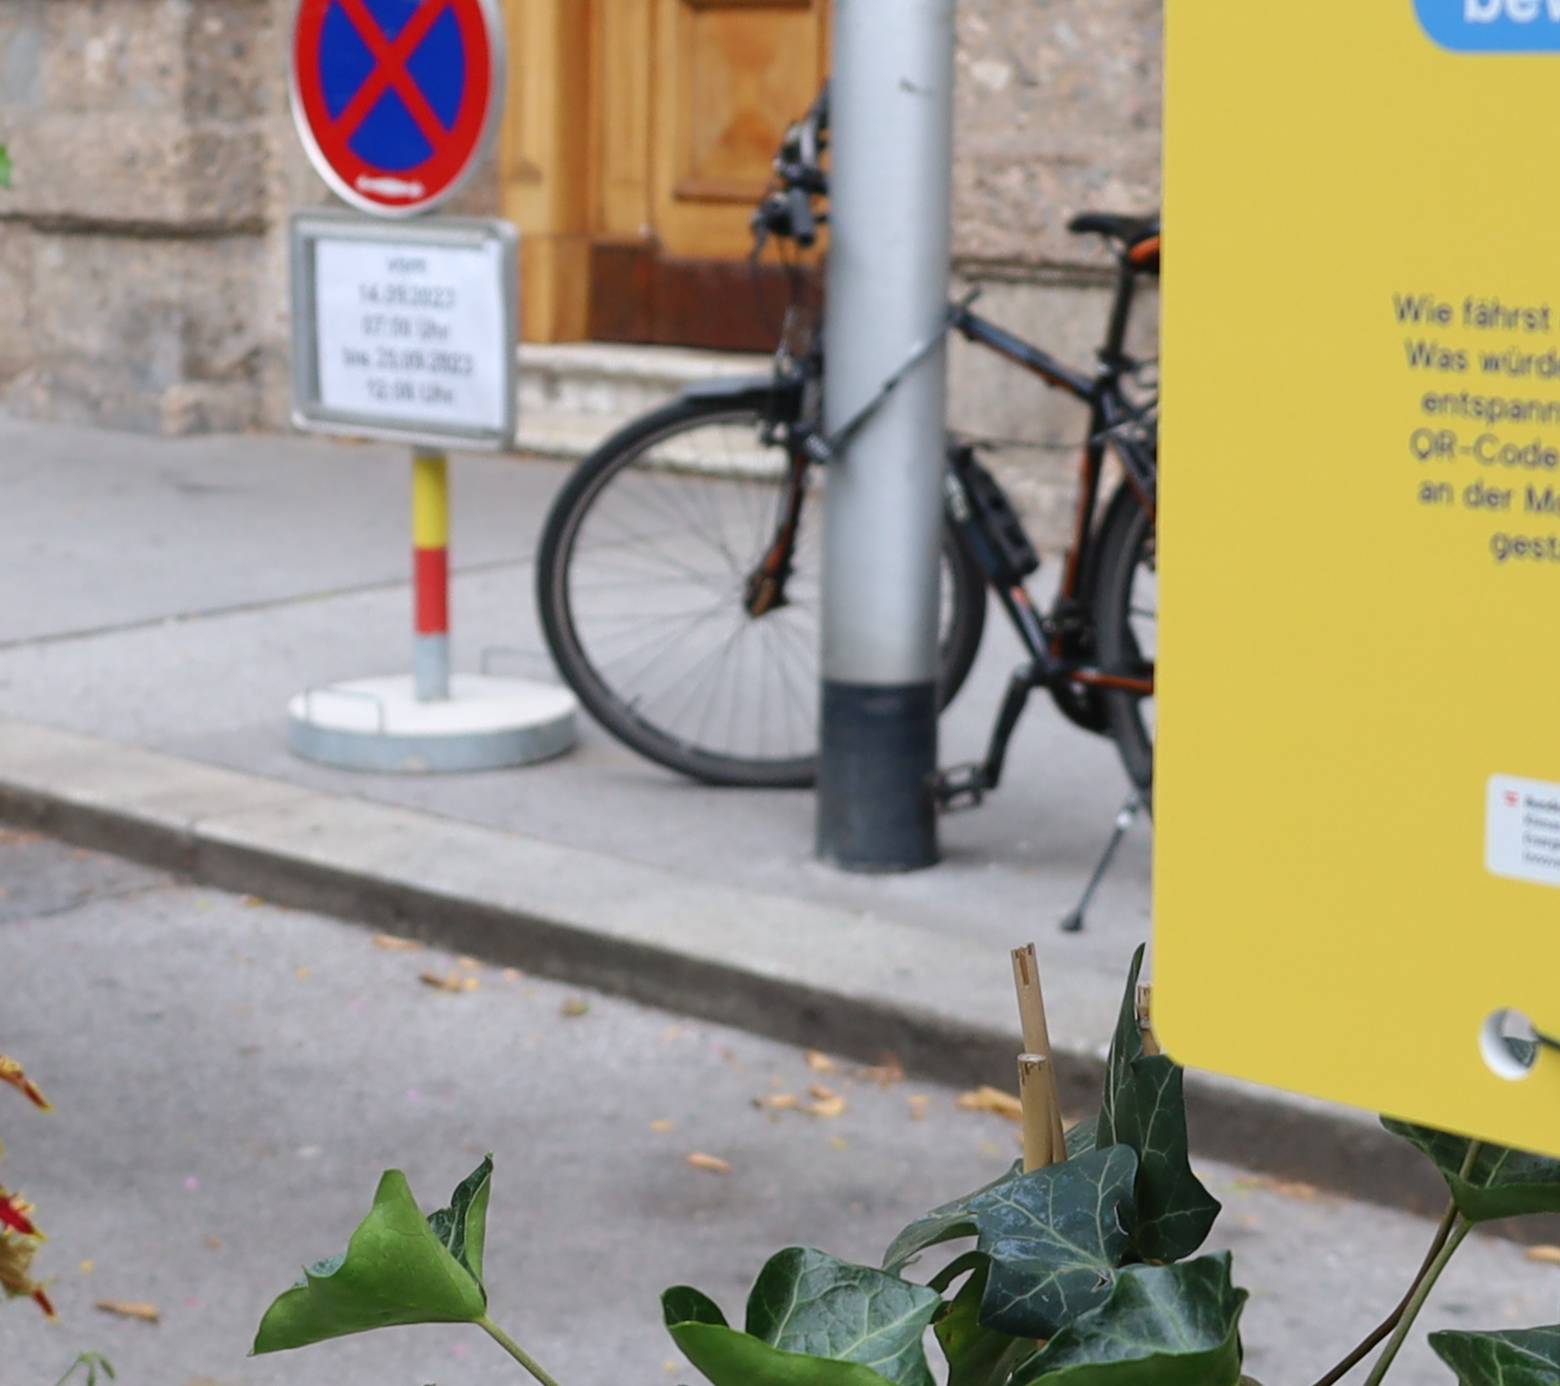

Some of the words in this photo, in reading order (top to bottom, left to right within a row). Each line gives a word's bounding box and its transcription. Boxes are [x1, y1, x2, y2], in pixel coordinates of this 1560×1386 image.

[1393, 294, 1453, 325] Wie
[1463, 297, 1550, 333] fährst
[1405, 339, 1468, 374] Was
[1409, 427, 1560, 471] QR-Code
[1418, 479, 1454, 505] an
[1462, 478, 1513, 512] der
